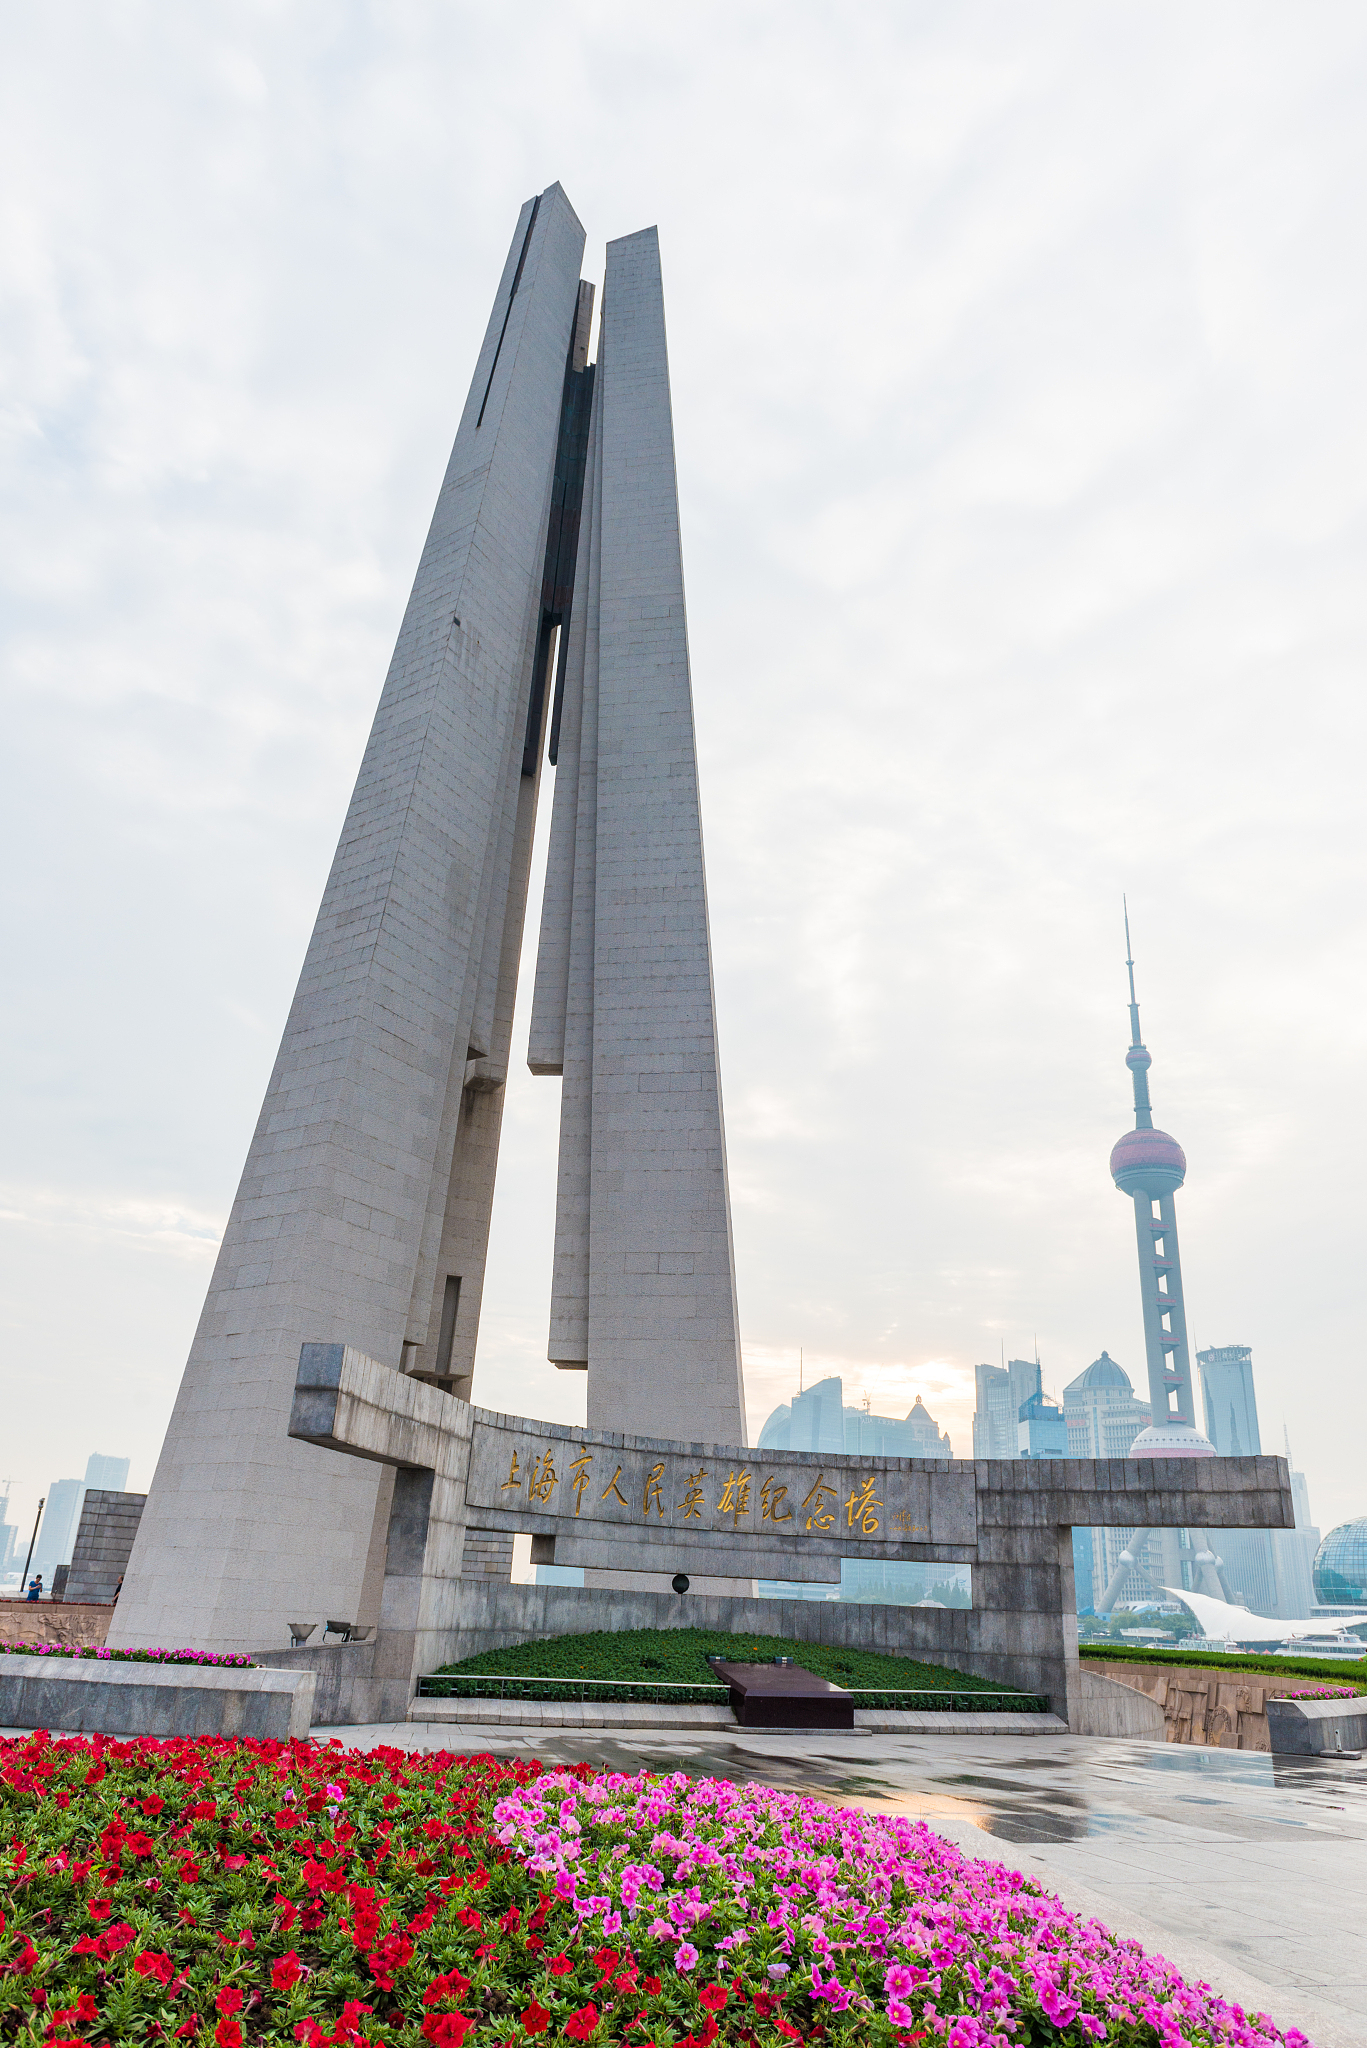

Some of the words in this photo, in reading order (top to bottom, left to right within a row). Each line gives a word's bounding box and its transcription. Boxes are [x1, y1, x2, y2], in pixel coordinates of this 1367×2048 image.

[500, 1447, 884, 1534] 上海市人民英雄纪念塔
